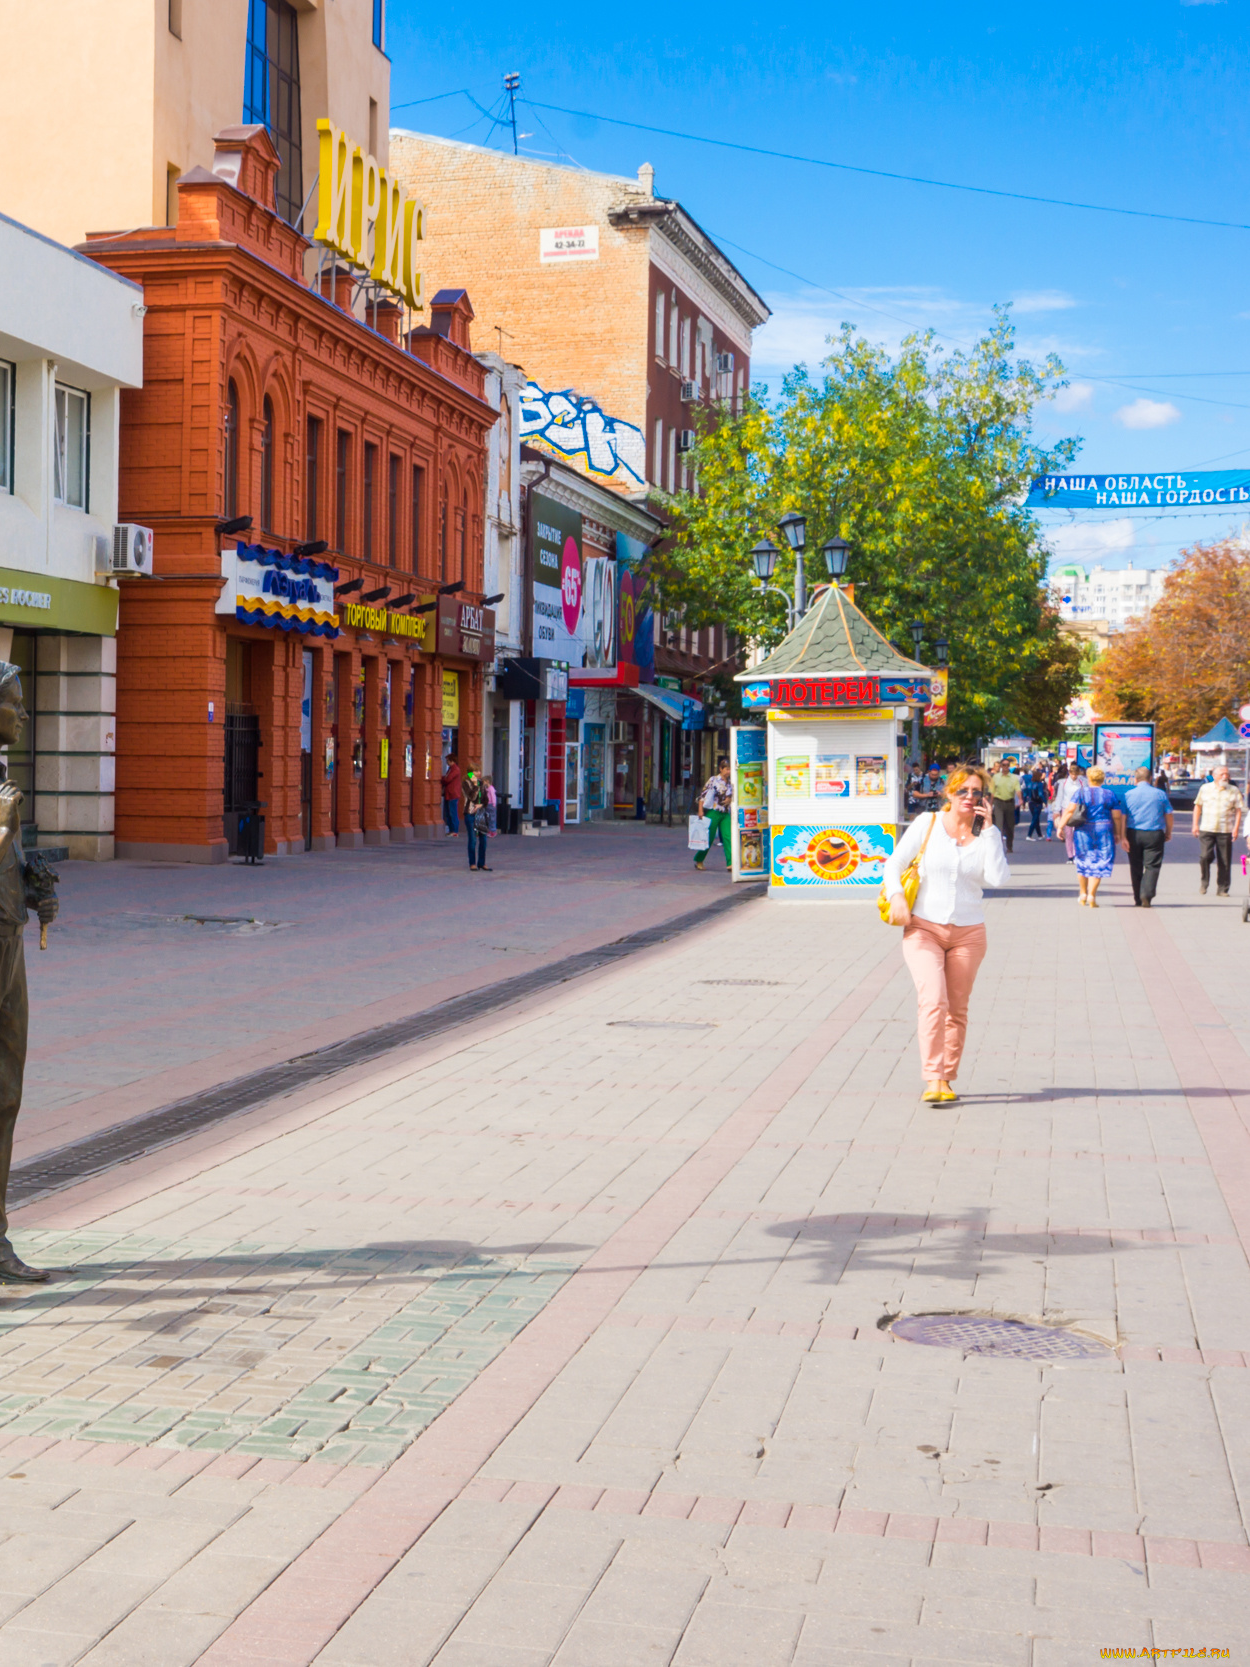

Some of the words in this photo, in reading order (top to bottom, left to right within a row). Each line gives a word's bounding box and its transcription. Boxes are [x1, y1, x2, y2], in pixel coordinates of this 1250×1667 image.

[313, 117, 428, 311] ИРИС
[1044, 477, 1098, 491] НАША
[1104, 475, 1187, 490] ОБЛАСТЬ
[1096, 491, 1150, 505] НАША
[537, 521, 562, 546] ЗАКРЫТИЕ
[539, 548, 559, 570] СЕЗОНА
[10, 588, 52, 610] ROCHER
[346, 603, 388, 633] ТОРГОВЫЙ
[390, 612, 426, 639] КОМПЛЕКС
[460, 604, 484, 632] АРБАТ
[538, 625, 555, 641] ОБУВИ
[776, 681, 873, 702] ЛОТЕРЕИ
